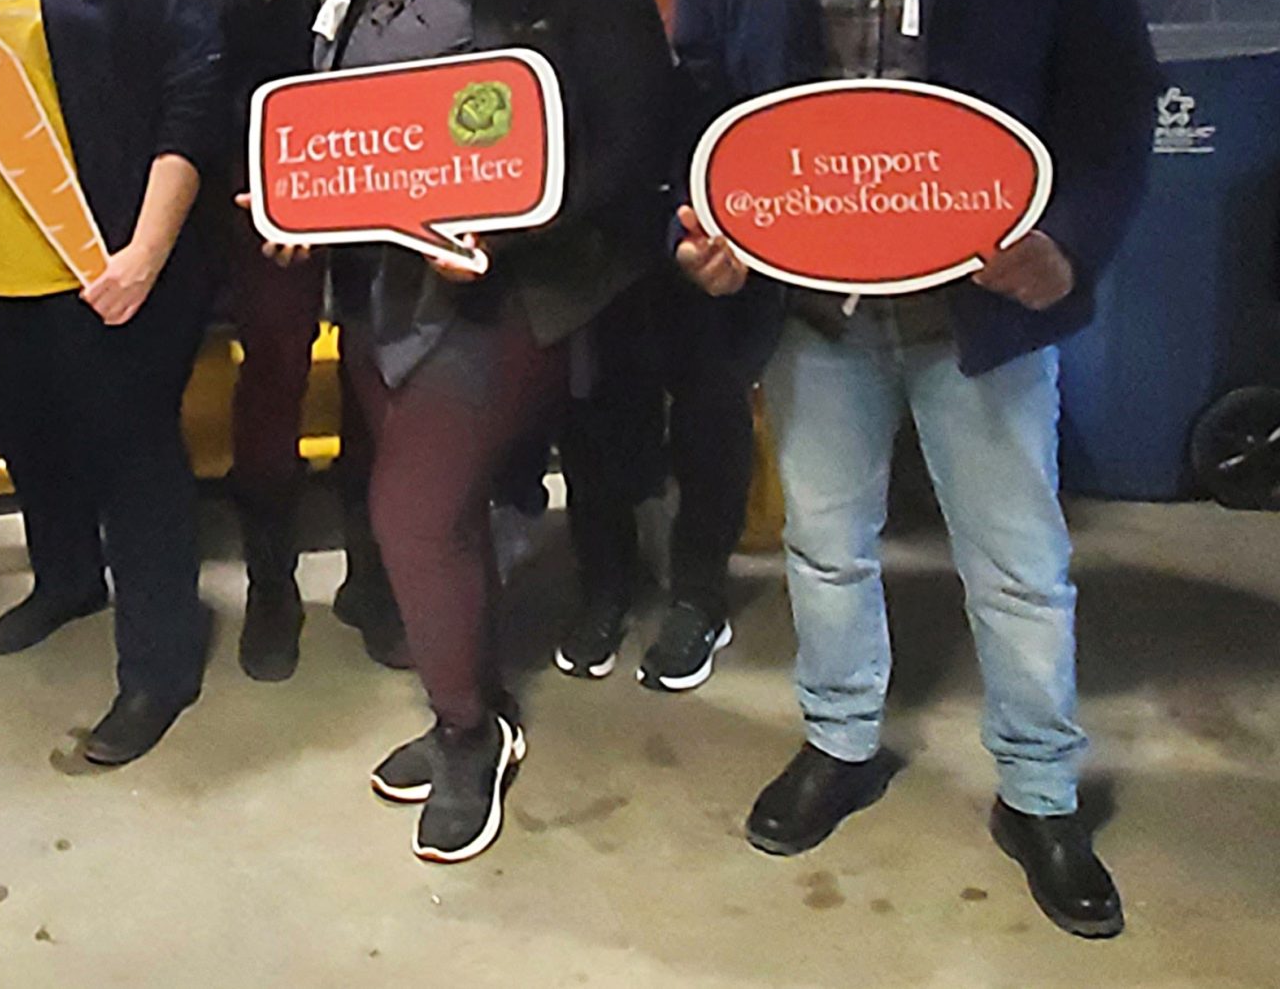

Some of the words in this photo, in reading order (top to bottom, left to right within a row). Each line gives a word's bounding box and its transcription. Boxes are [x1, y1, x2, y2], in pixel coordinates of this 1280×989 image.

[275, 123, 425, 164] Lettuce
[274, 154, 523, 201] #EndHungerHere
[789, 148, 804, 177] I
[813, 149, 941, 184] support
[724, 179, 1014, 228] @gr8bosfoodbank
